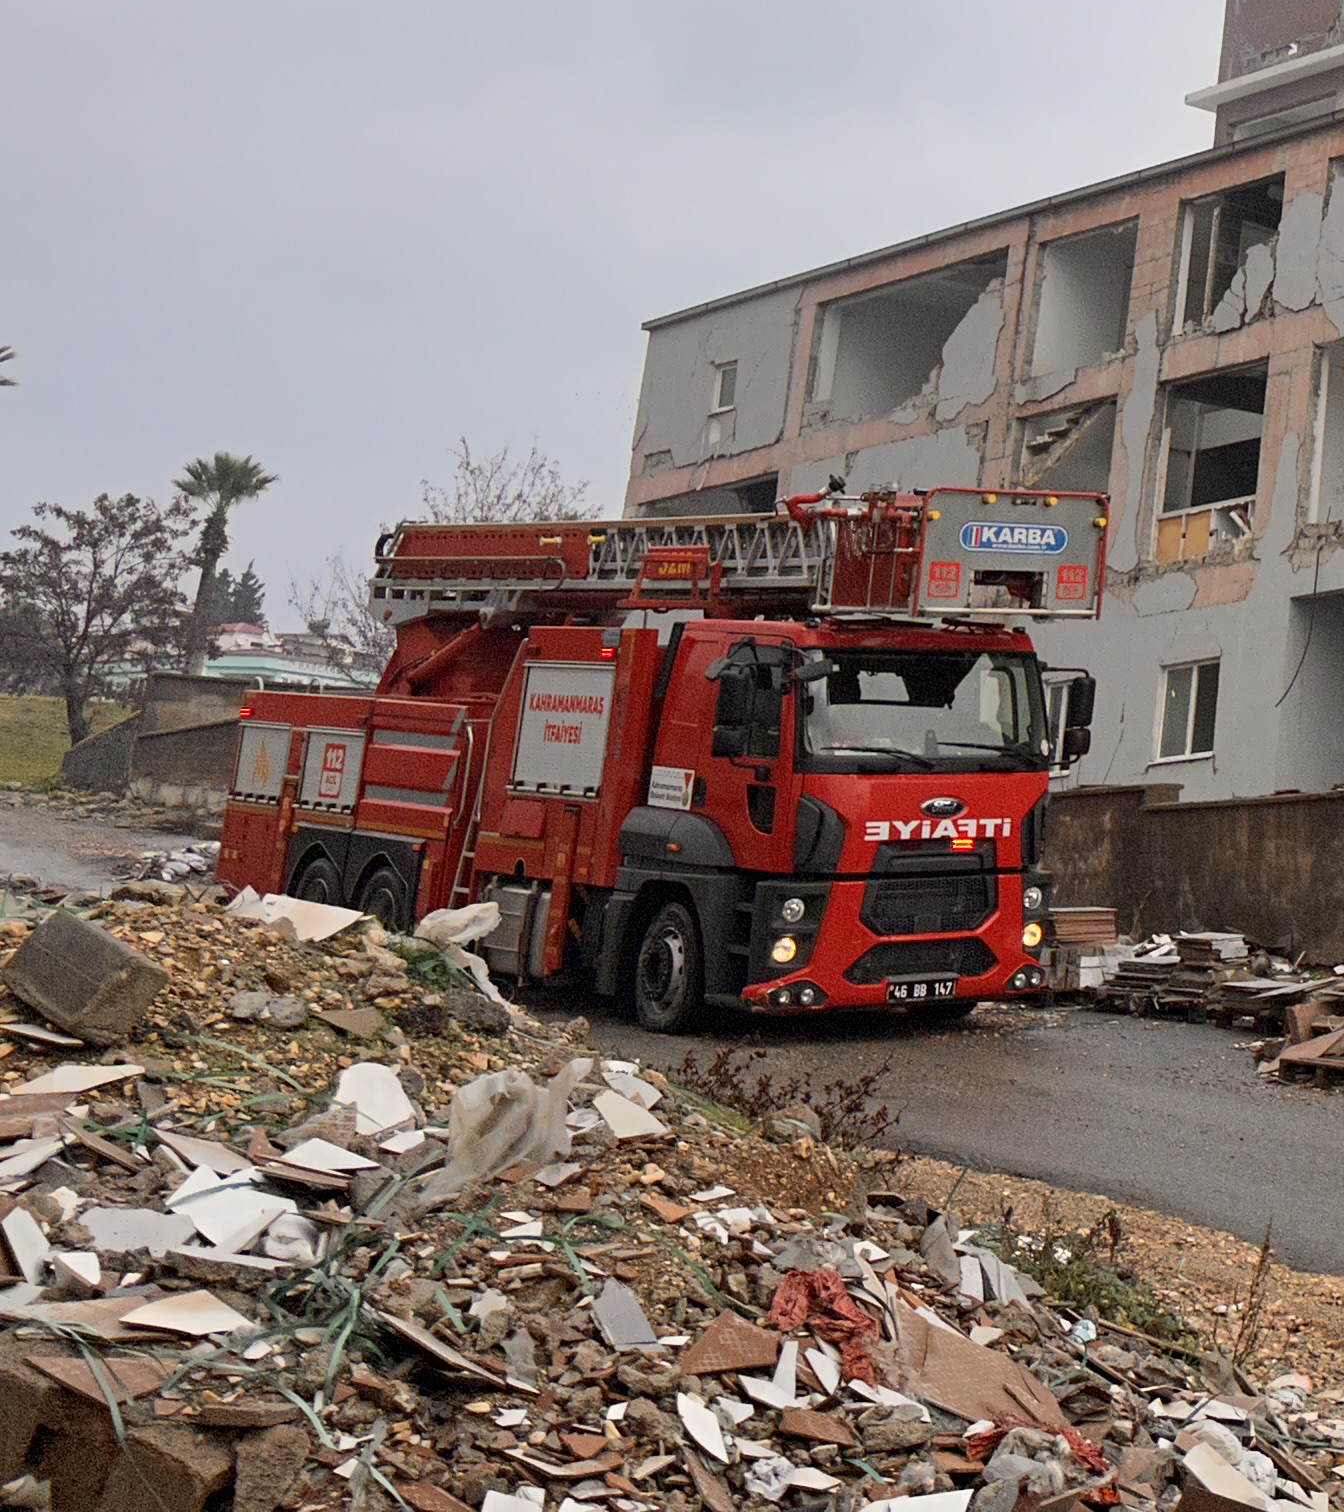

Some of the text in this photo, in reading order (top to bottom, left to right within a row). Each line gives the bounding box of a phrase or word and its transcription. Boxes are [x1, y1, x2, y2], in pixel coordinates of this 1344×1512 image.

[981, 526, 1056, 545] KARBA
[529, 693, 604, 719] KAHRAMANMARAŞ
[543, 719, 582, 745] İTFAİYESİ
[326, 748, 344, 769] 112
[894, 981, 953, 998] 46 BB 147
